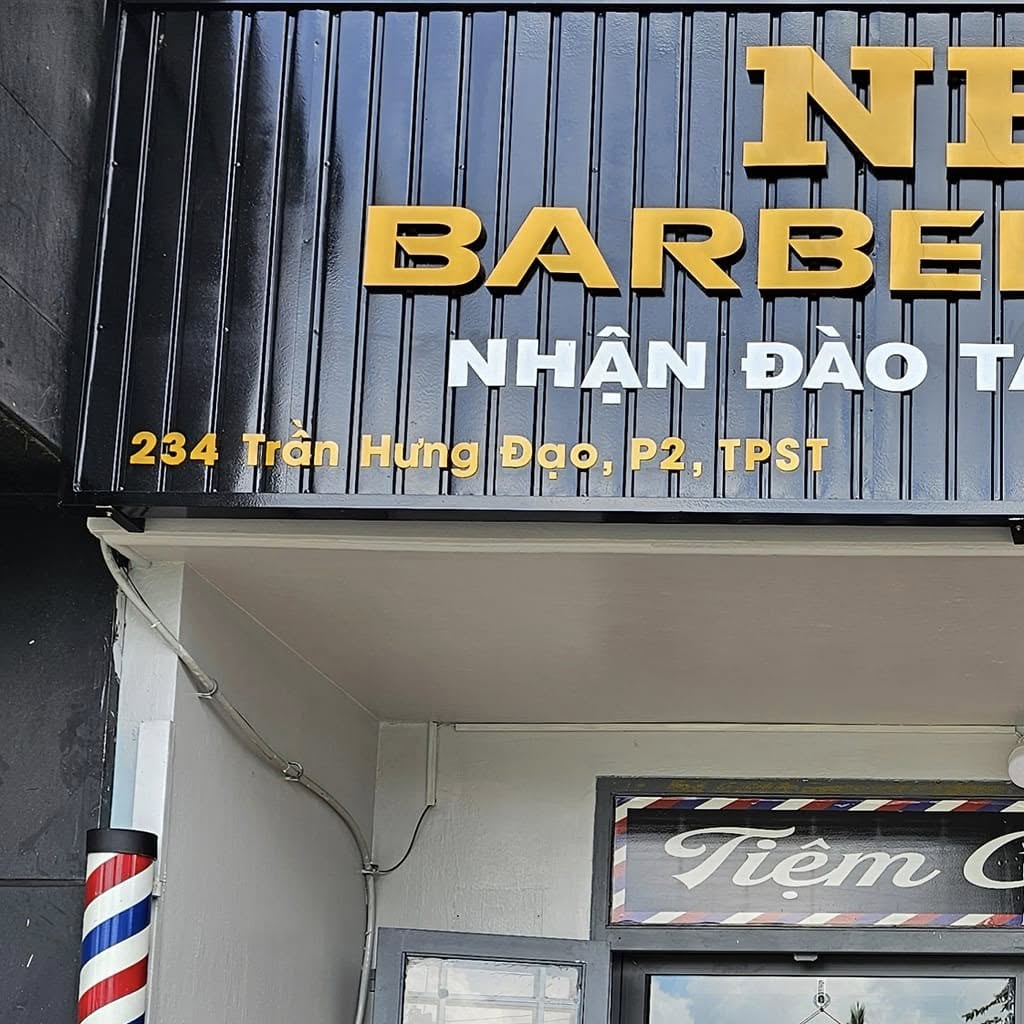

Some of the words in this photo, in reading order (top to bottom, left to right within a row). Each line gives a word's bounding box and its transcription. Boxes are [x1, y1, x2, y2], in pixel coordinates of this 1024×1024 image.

[447, 325, 707, 405] NHẬN
[740, 325, 928, 393] ĐÀO
[129, 431, 219, 466] 234
[242, 417, 339, 468] Trần
[360, 434, 480, 478] Hưng
[500, 434, 613, 480] Đạo,
[631, 436, 703, 478] P2,
[718, 437, 829, 473] TPST
[664, 826, 941, 900] Tiệm
